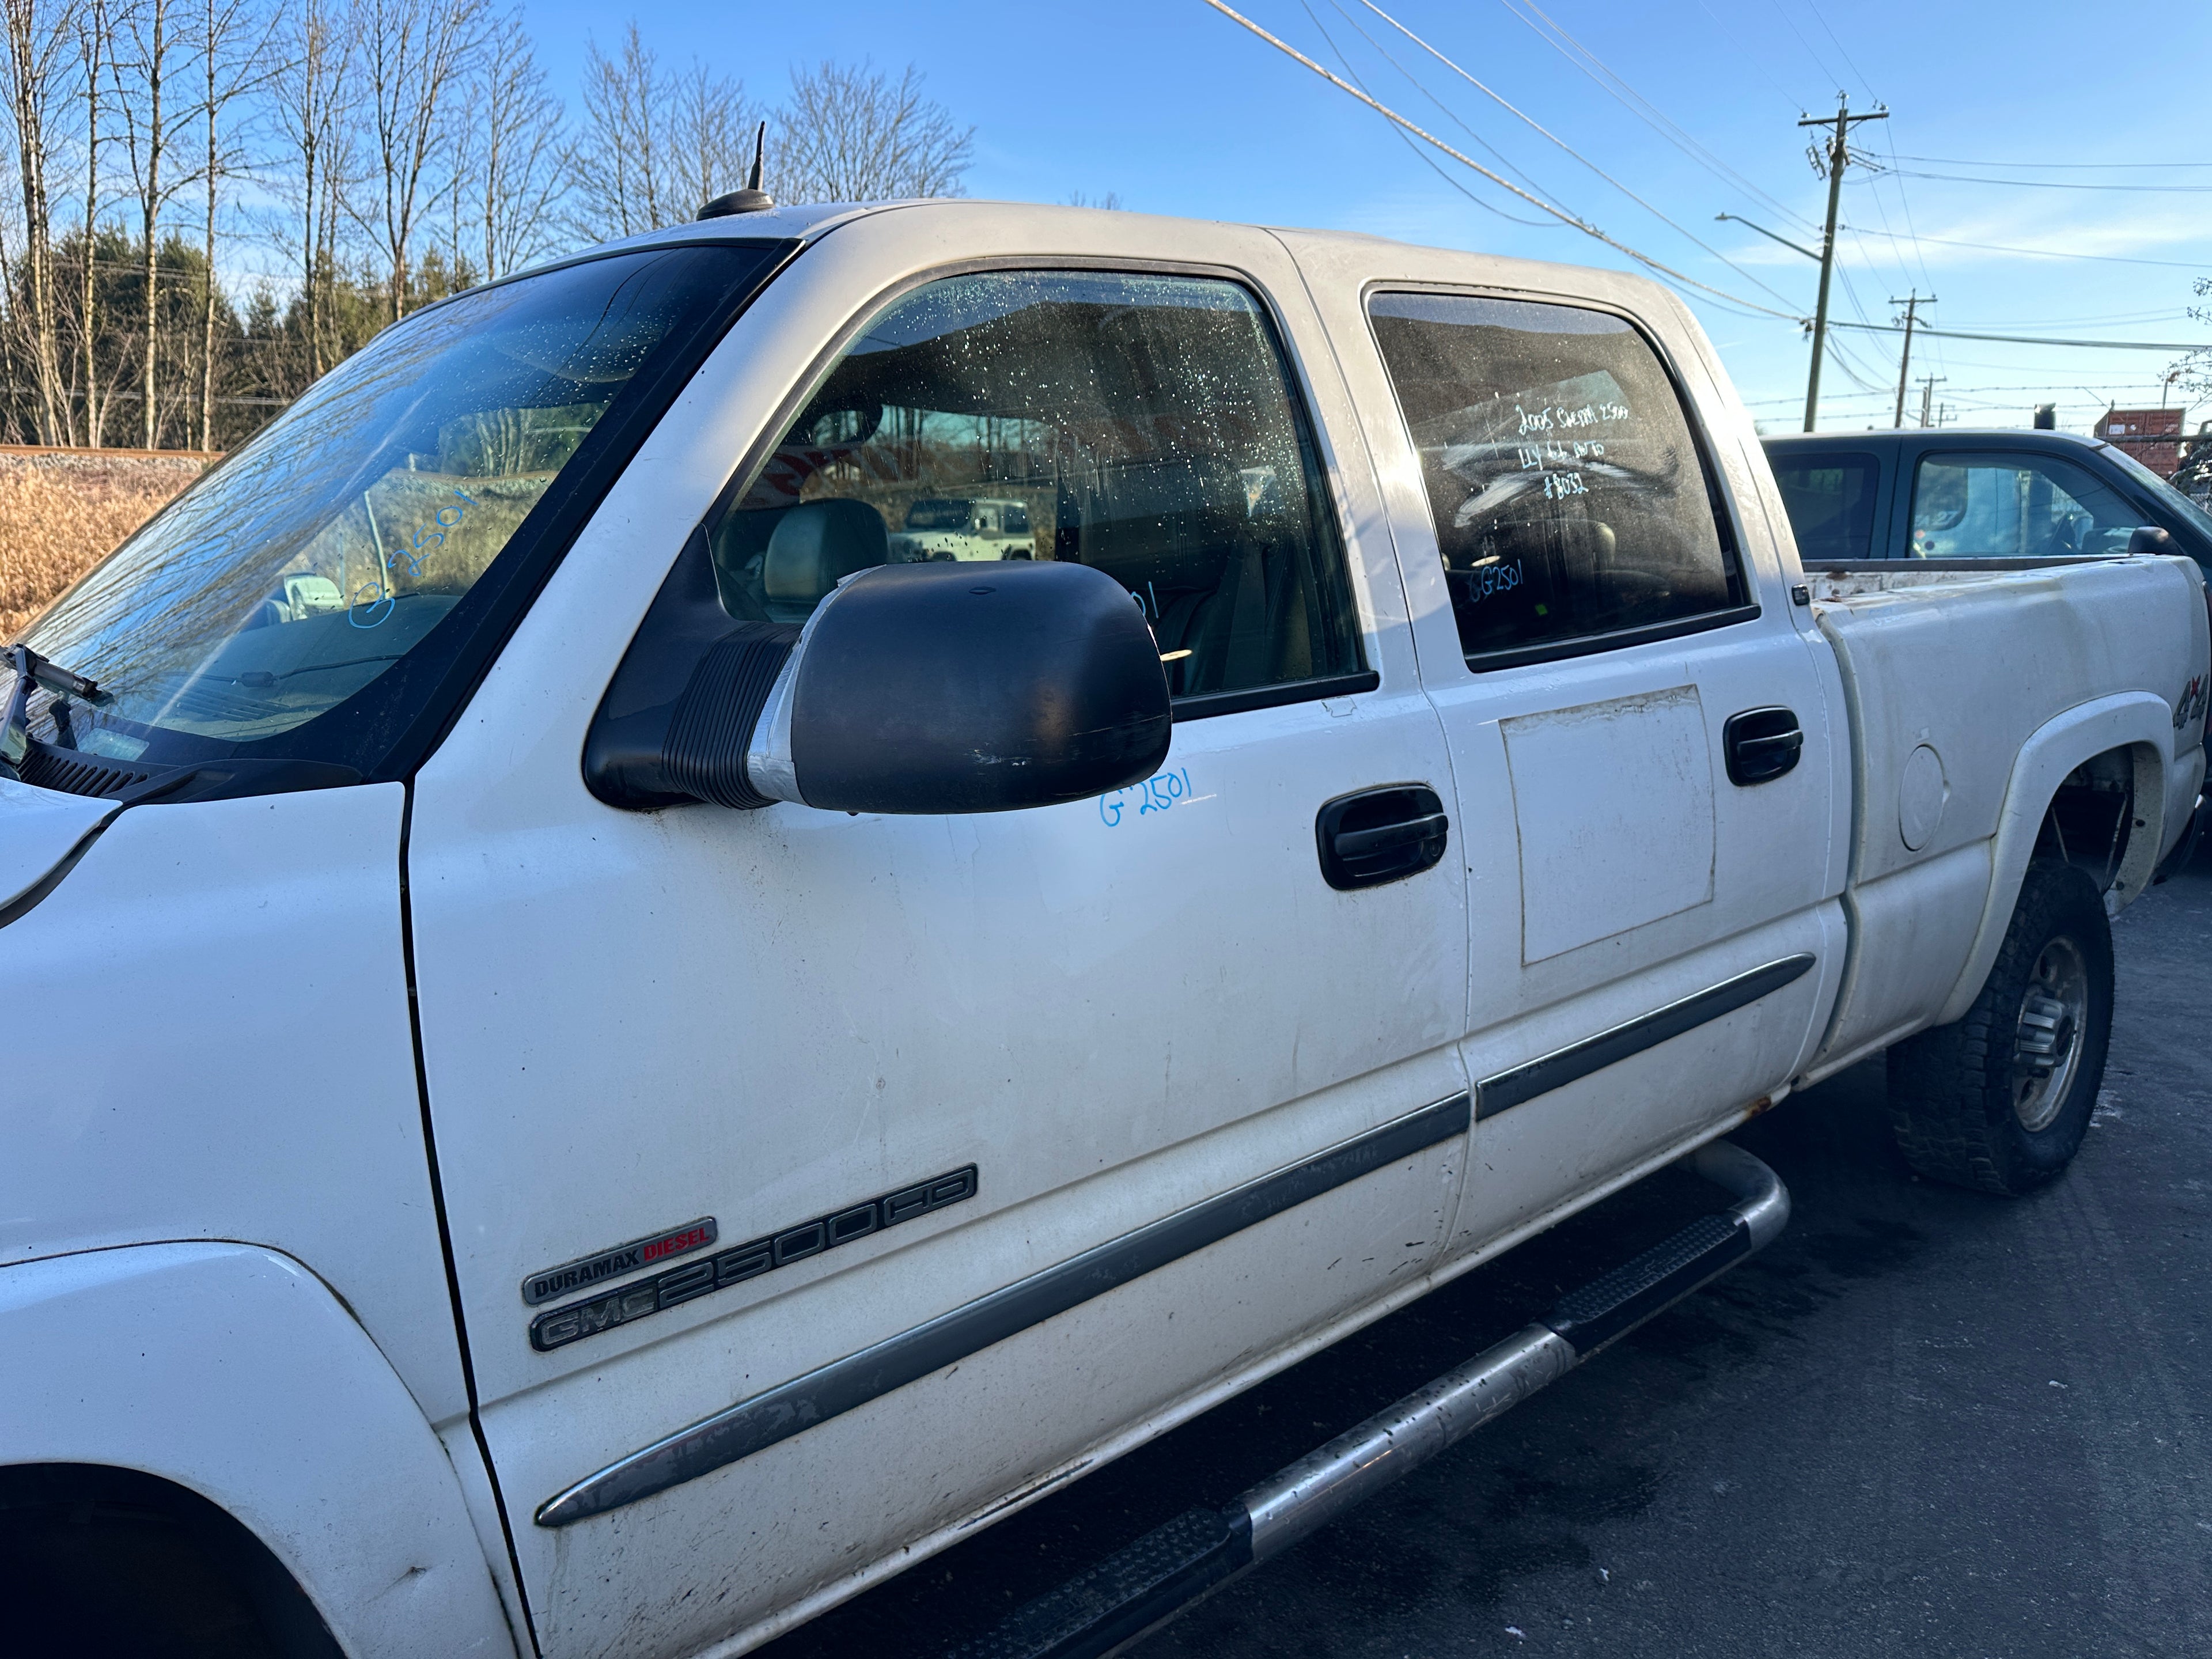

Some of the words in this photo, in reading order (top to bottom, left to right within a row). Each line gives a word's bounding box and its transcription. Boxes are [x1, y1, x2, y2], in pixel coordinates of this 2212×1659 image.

[1516, 404, 1554, 435] 2005
[534, 1248, 640, 1297] DURAMAX
[643, 1227, 710, 1262] DIESEL
